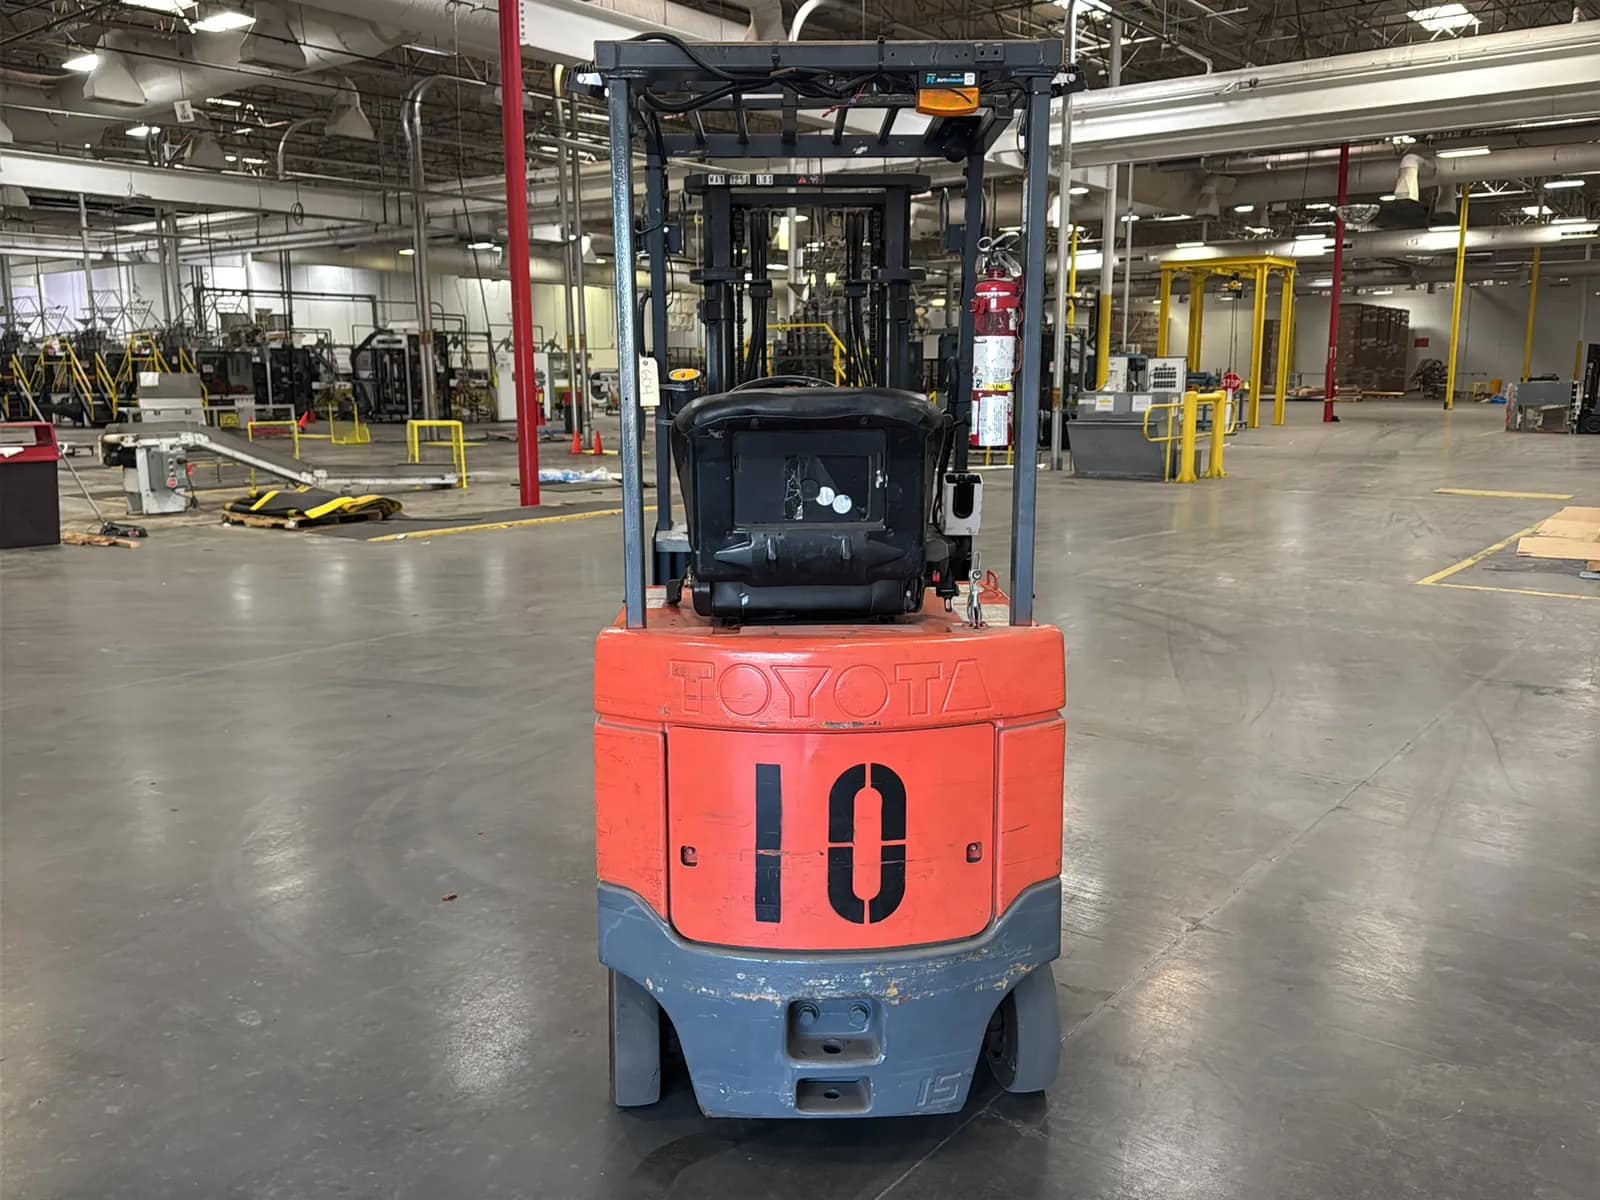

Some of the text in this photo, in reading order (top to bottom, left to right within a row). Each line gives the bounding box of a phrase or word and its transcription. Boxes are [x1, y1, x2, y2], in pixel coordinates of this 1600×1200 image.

[1222, 378, 1240, 388] STOP
[669, 658, 993, 719] TOYOTA
[755, 763, 907, 925] 10
